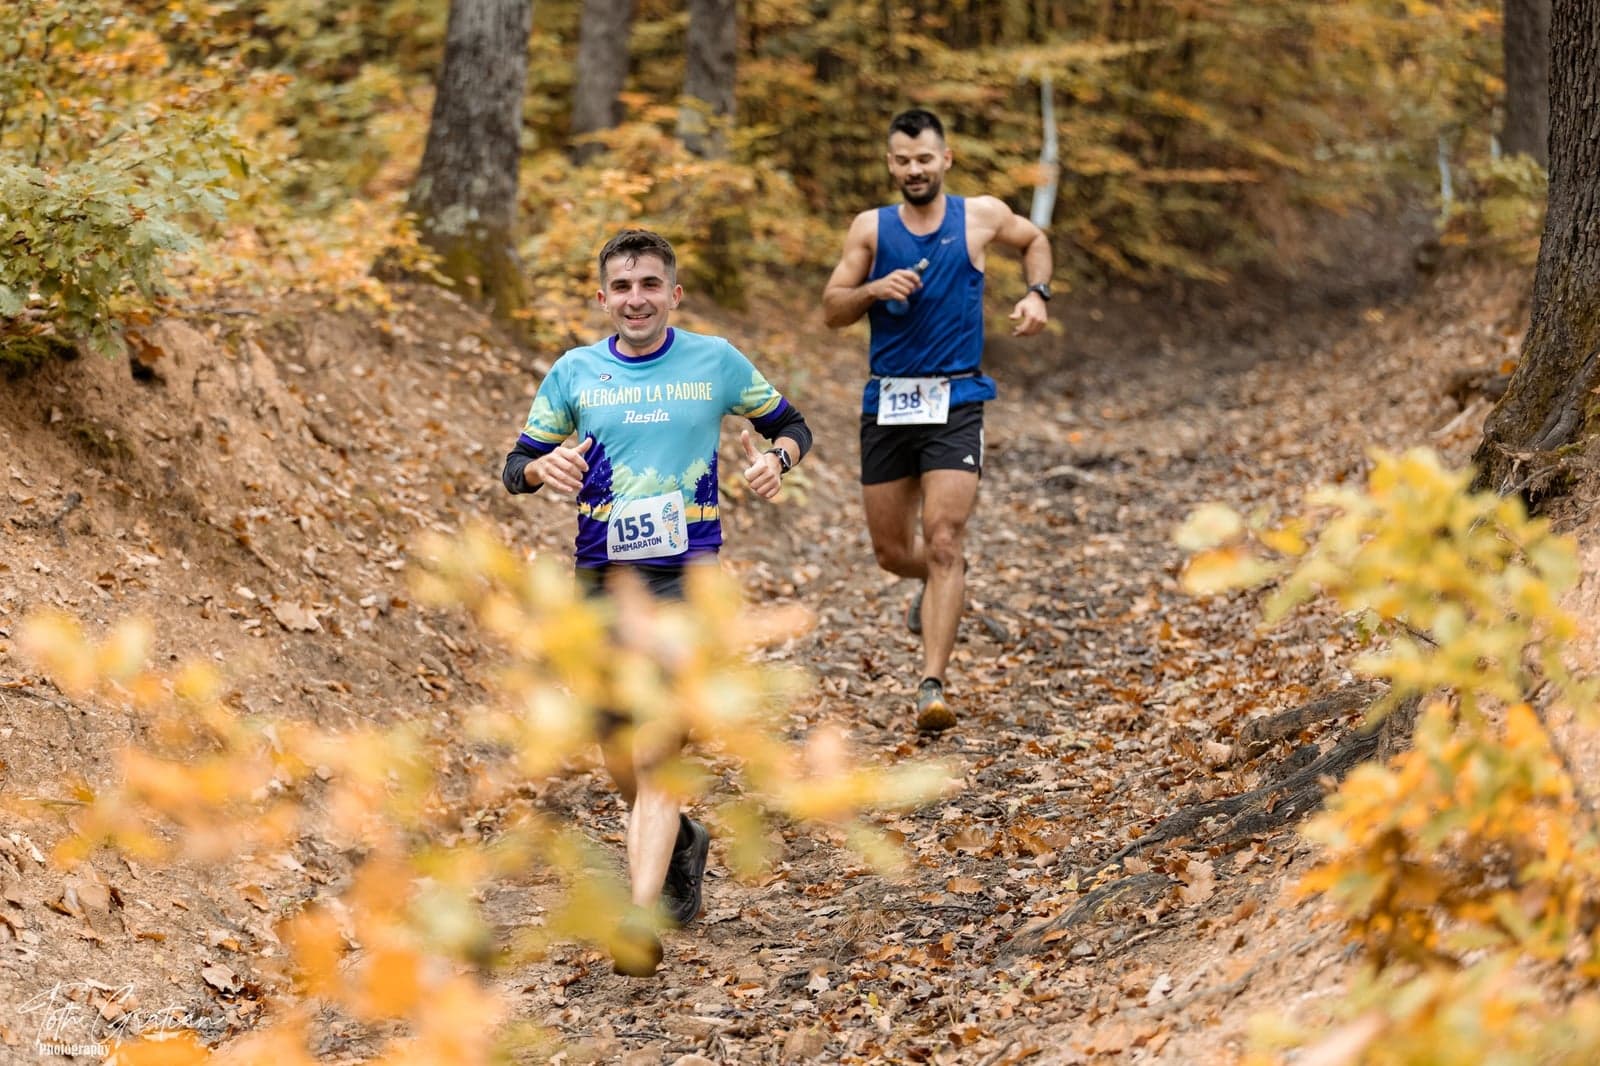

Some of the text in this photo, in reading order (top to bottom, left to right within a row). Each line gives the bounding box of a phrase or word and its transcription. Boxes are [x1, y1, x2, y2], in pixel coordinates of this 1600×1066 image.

[647, 384, 662, 402] LA
[889, 392, 921, 411] 138
[613, 513, 655, 542] 155
[611, 536, 662, 553] SEMIMARATON
